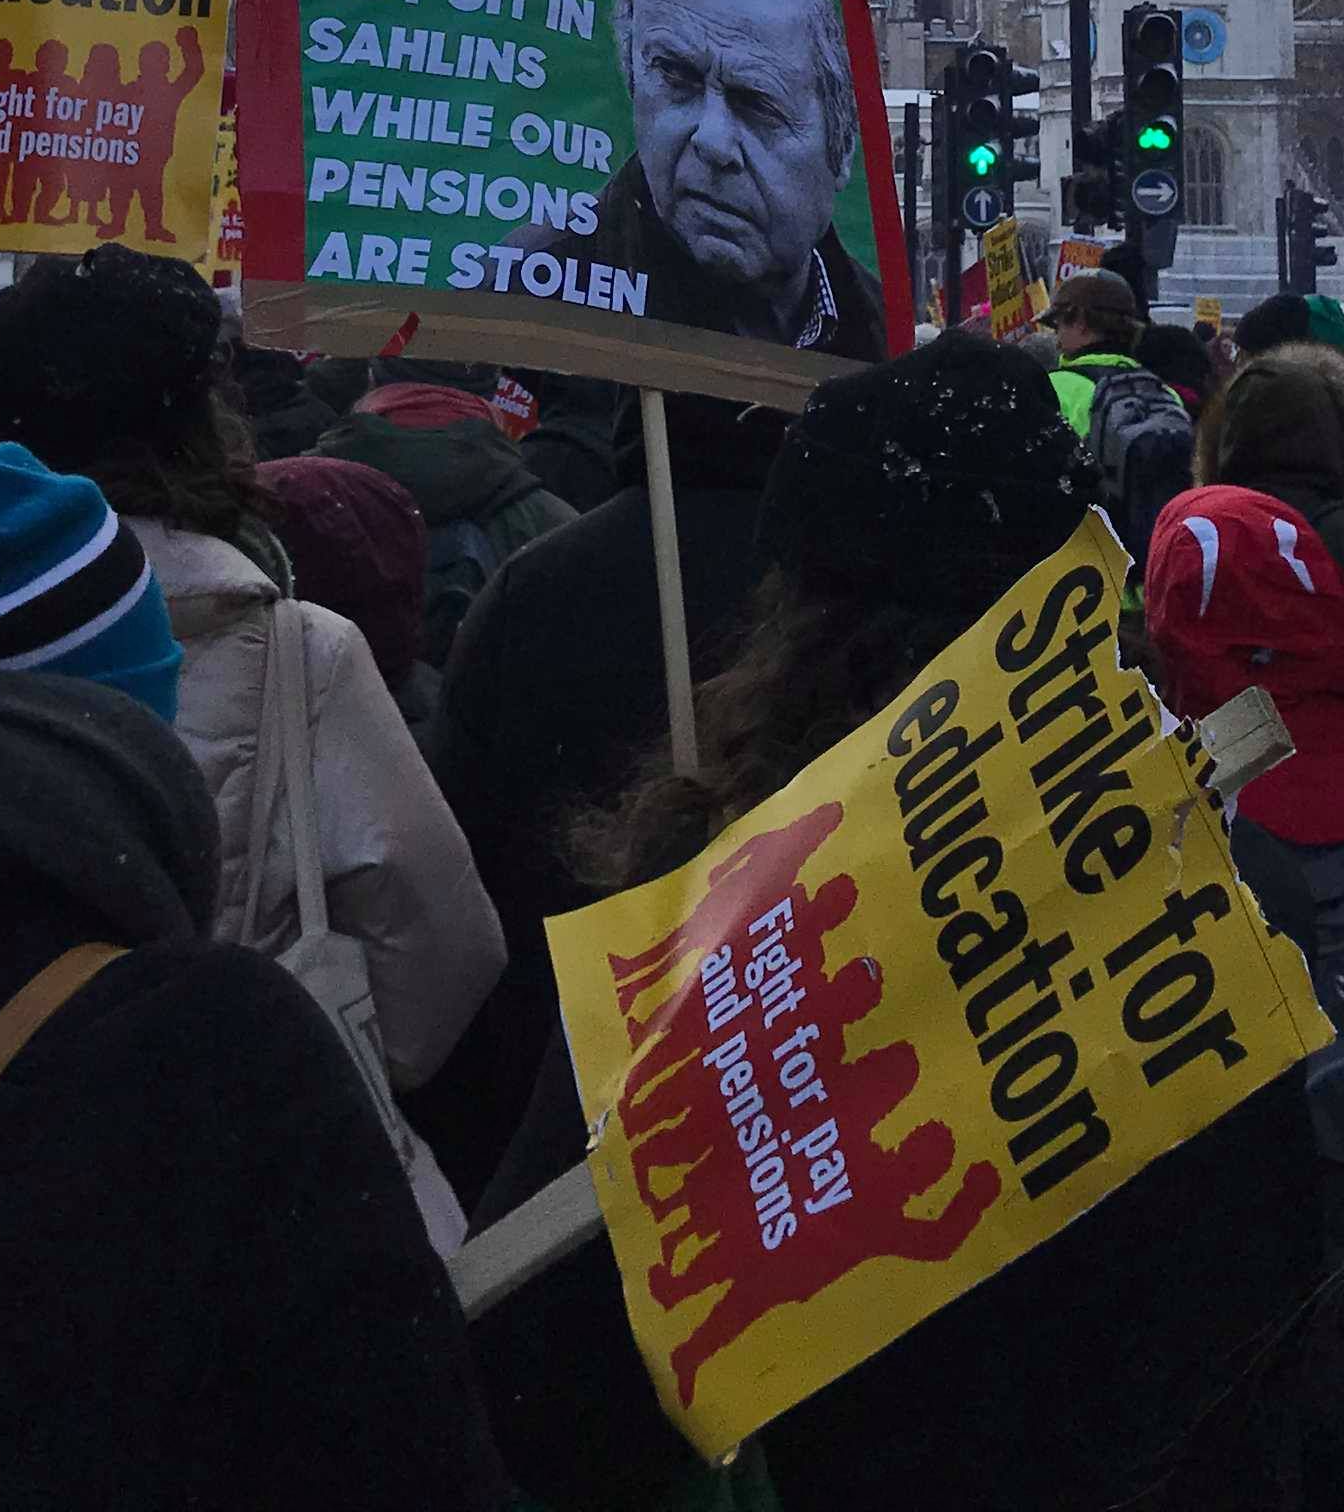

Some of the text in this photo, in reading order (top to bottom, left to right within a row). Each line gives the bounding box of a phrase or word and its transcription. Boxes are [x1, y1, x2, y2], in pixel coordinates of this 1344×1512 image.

[304, 17, 548, 91] SAHLINS
[17, 129, 140, 166] pensions
[44, 87, 86, 122] for
[95, 100, 145, 136] pay
[311, 86, 613, 174] WHILE OUR
[309, 158, 600, 236] PENSIONS
[308, 231, 649, 318] ARE STOLEN
[993, 563, 1153, 895] Strike
[1105, 882, 1251, 1090] for
[884, 678, 1114, 1201] education
[747, 895, 855, 1216] Fight for pay
[697, 947, 799, 1252] and pensions
